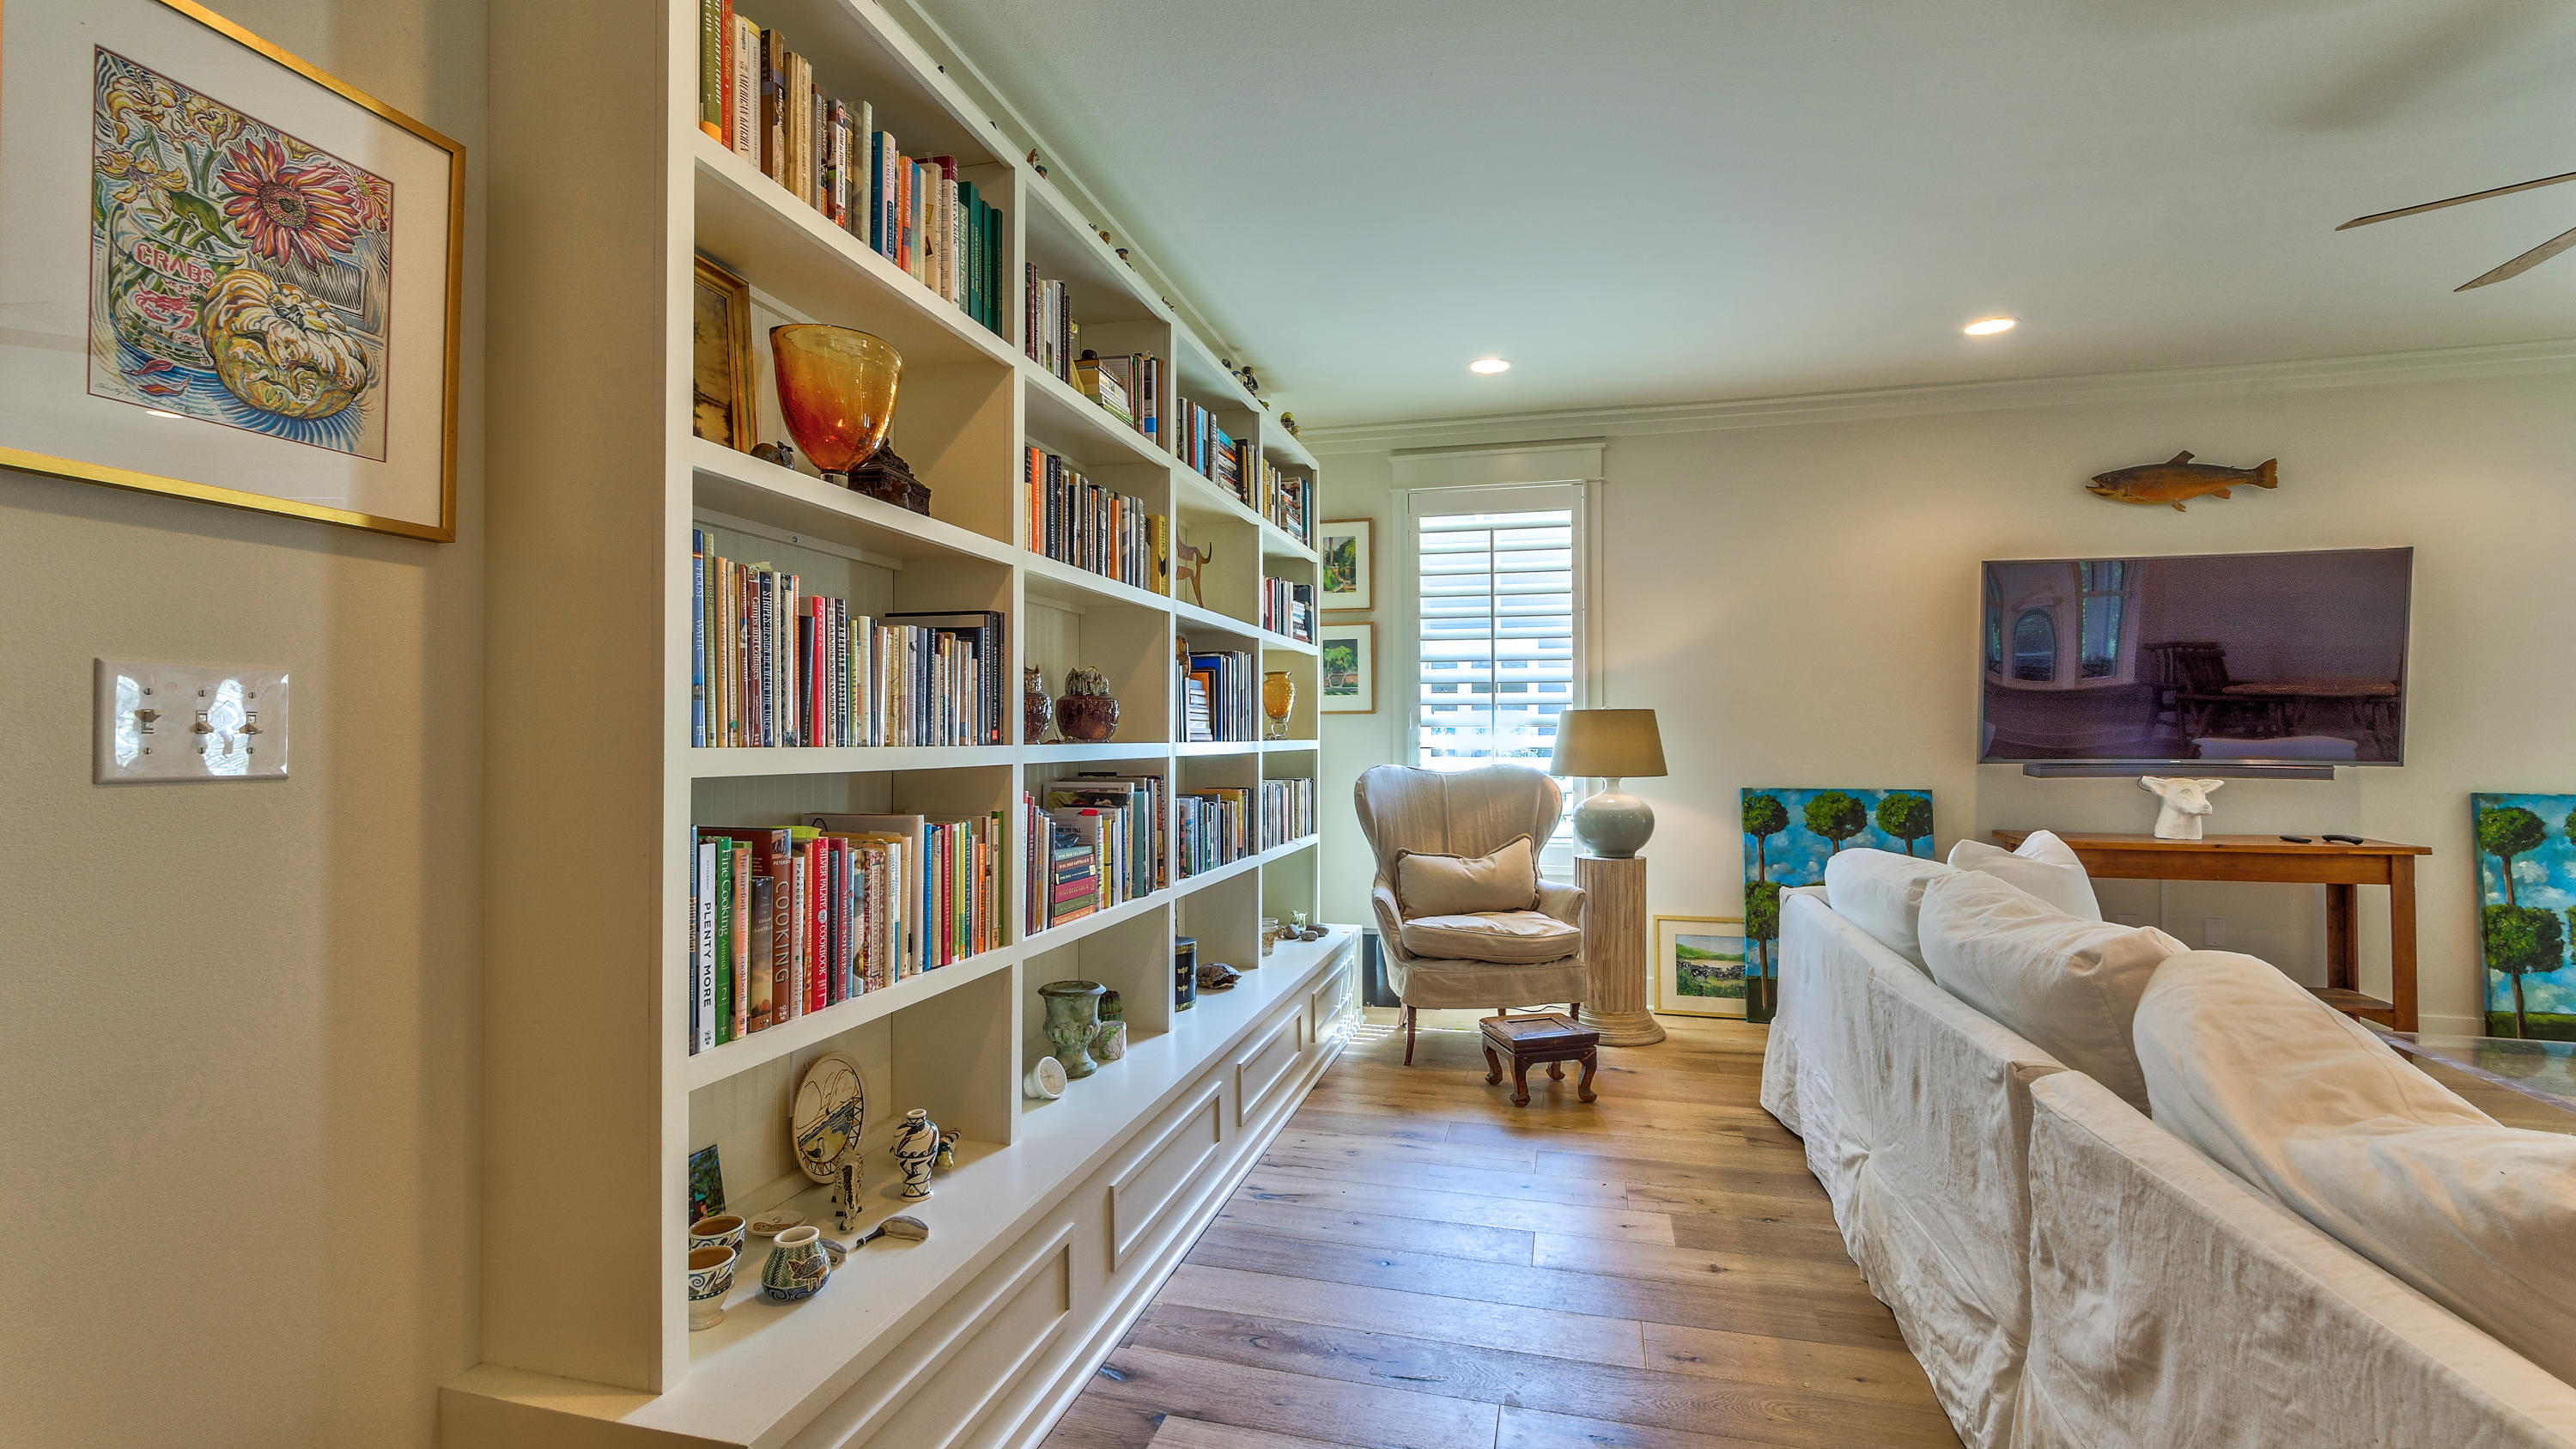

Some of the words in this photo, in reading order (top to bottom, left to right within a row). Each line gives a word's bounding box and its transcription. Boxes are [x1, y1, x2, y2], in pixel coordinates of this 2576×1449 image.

[137, 243, 216, 289] CRABS
[162, 278, 177, 288] we
[721, 849, 731, 877] Fine
[703, 902, 712, 959] PLENTY
[719, 880, 730, 936] Cooking
[775, 880, 789, 983] COOKING
[703, 964, 712, 1008] MORE
[722, 987, 726, 1000] 2
